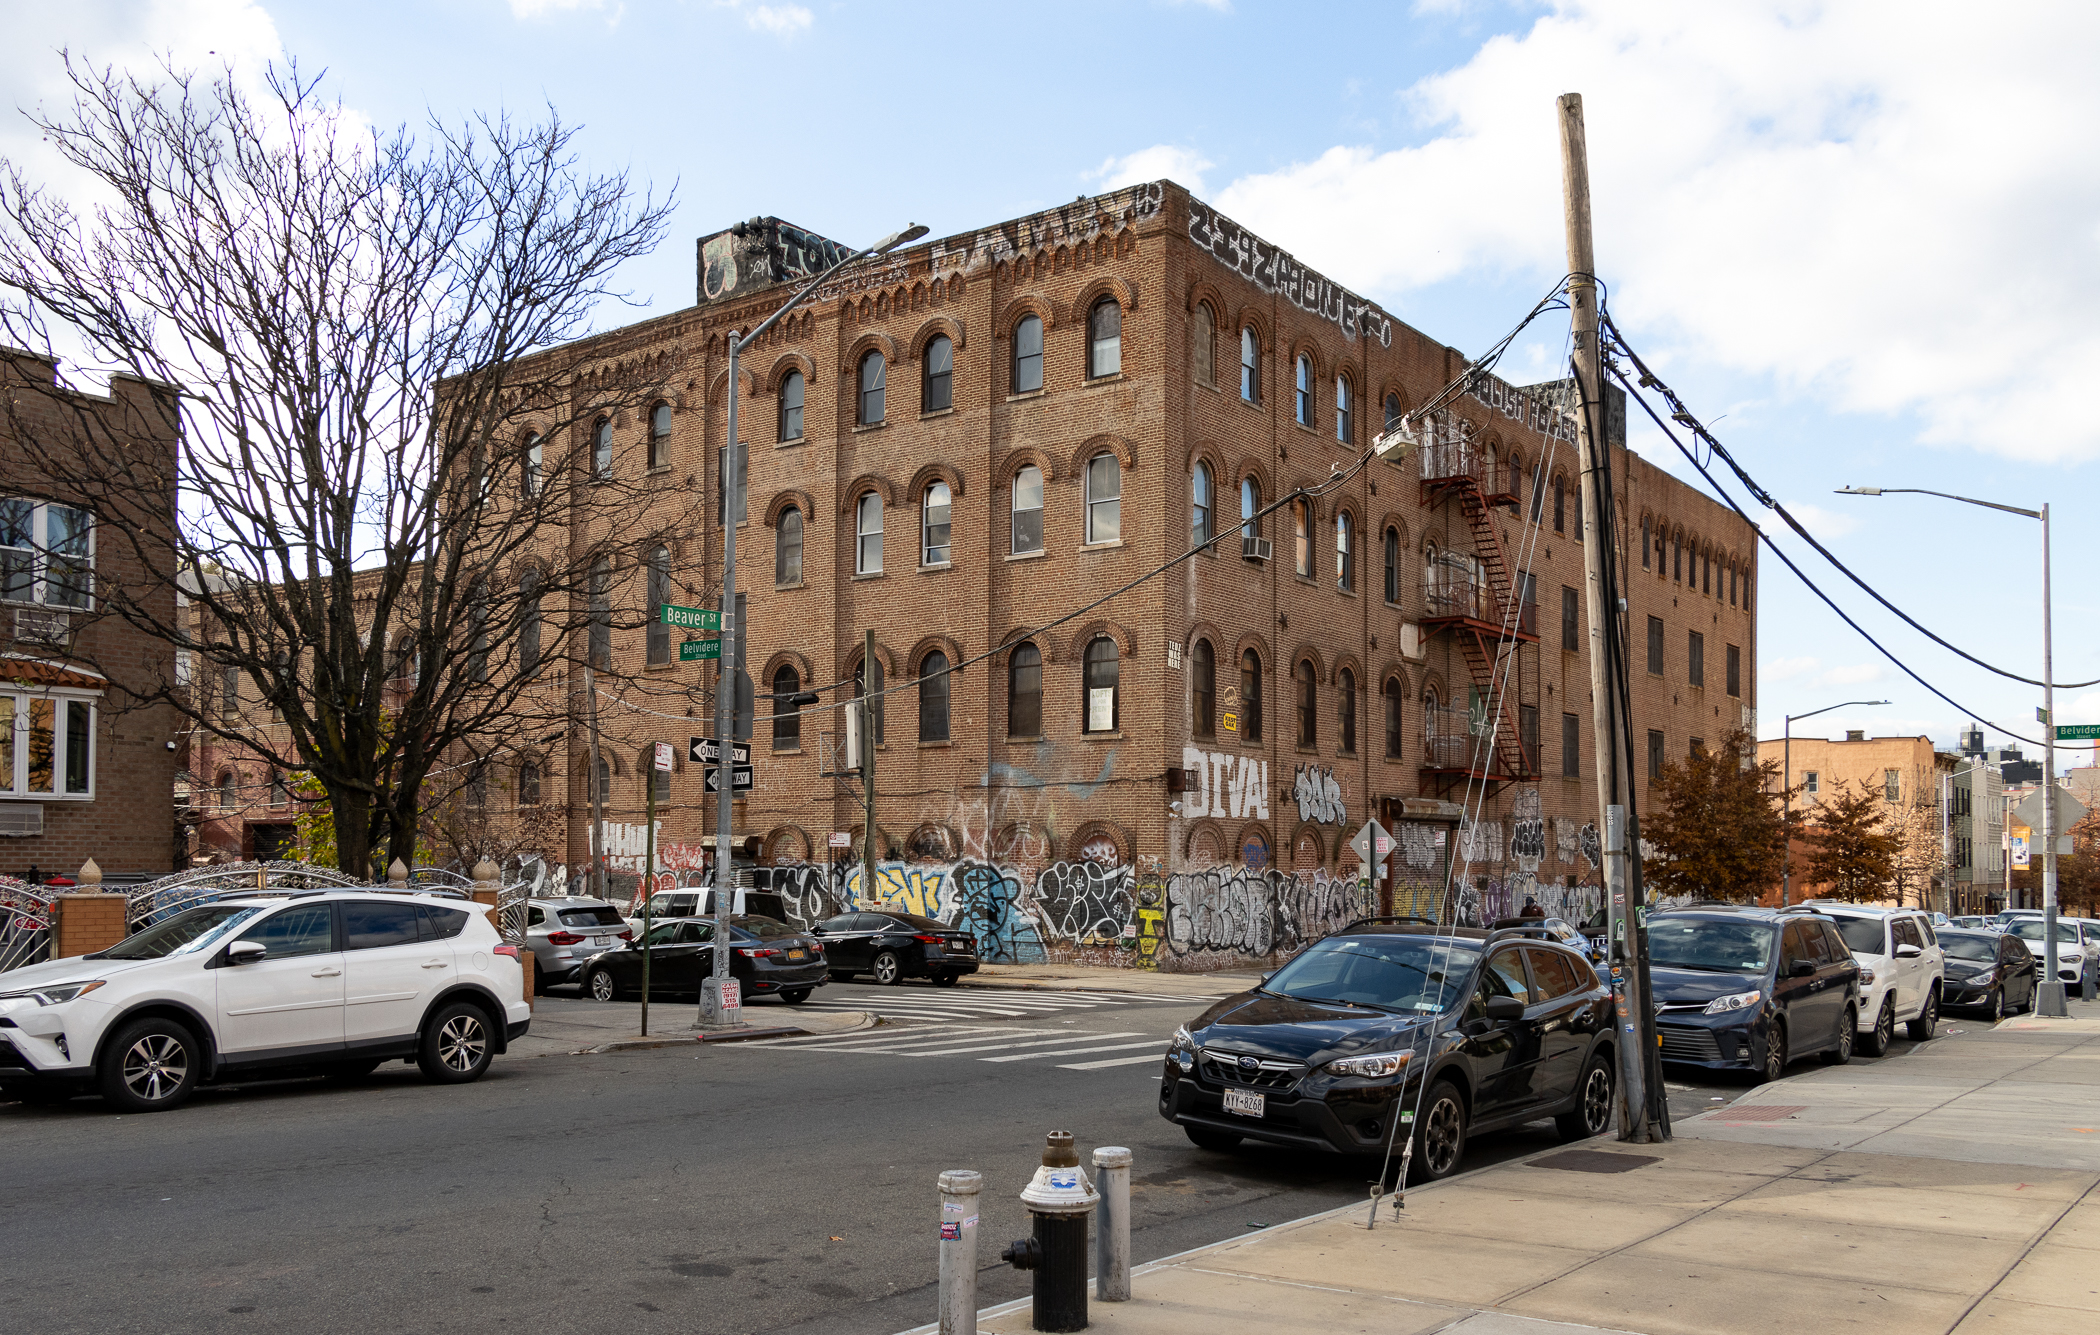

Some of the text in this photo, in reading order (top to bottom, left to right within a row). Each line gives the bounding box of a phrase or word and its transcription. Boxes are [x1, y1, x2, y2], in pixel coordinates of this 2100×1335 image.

[667, 607, 717, 626] Beaver St
[683, 642, 719, 654] Belvidere
[1091, 690, 1112, 698] LOFTS
[700, 745, 719, 757] ONE
